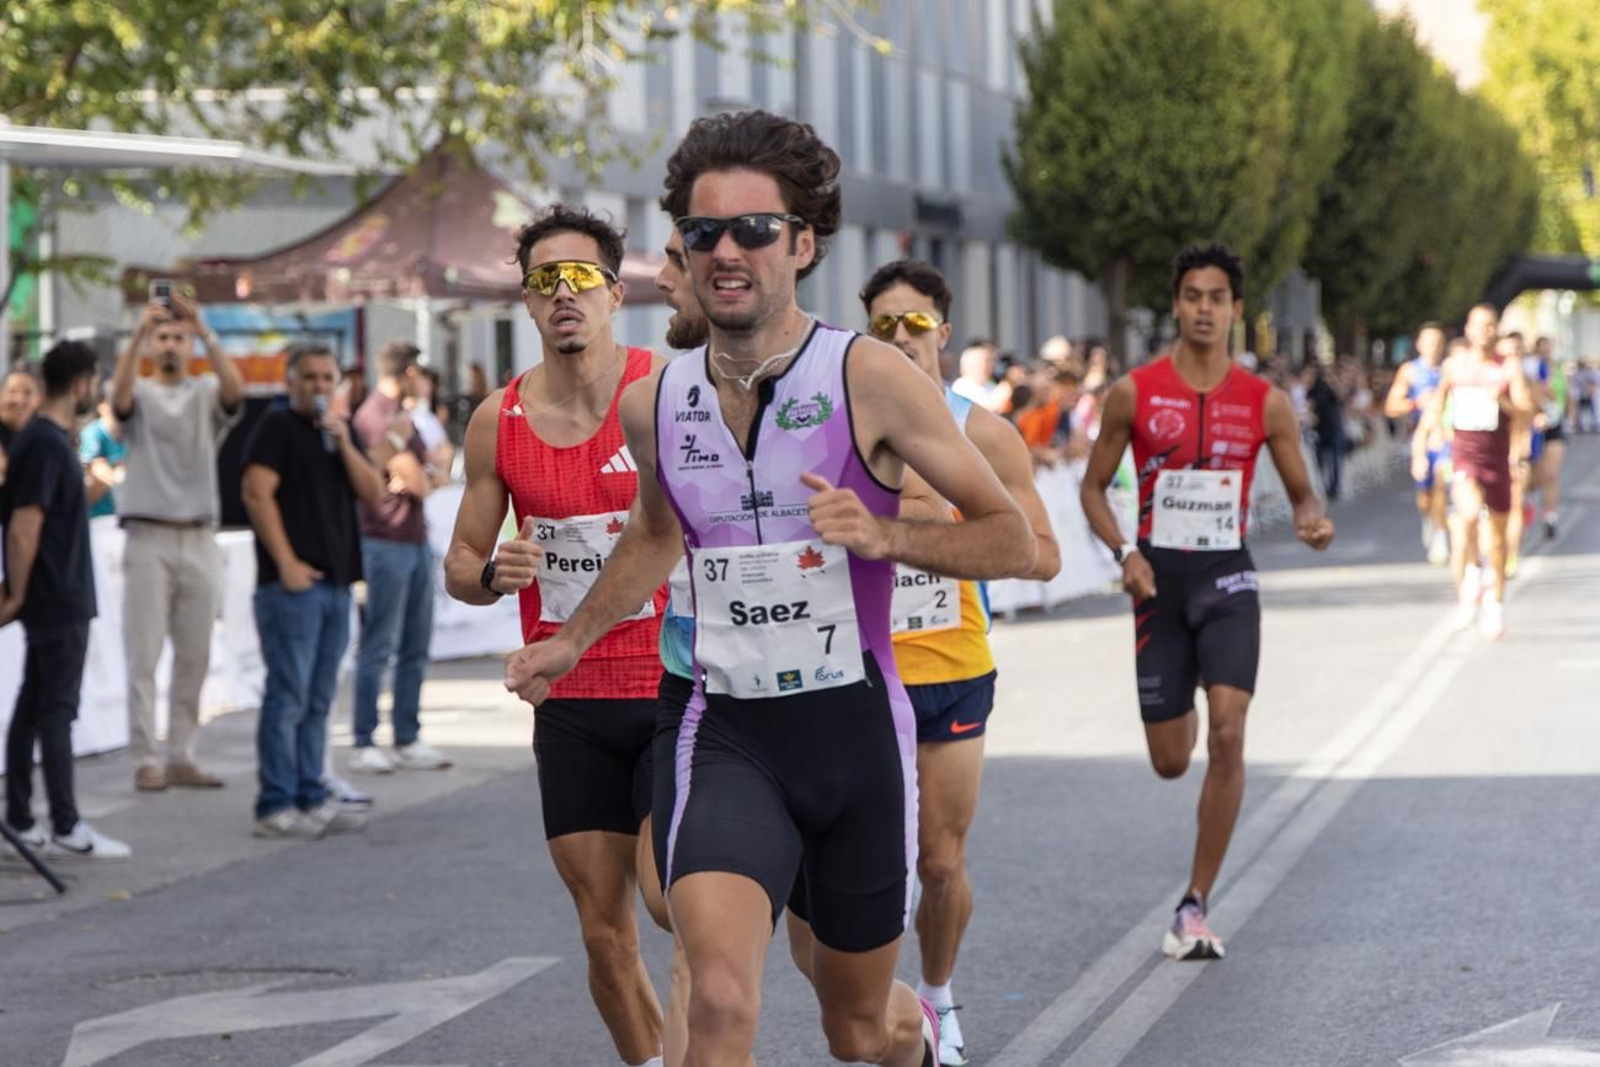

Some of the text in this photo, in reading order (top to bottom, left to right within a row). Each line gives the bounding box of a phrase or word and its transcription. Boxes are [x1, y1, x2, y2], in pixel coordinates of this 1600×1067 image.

[675, 411, 711, 422] VIATOR
[1162, 495, 1233, 512] Guzman
[759, 510, 769, 519] DE
[771, 507, 809, 518] ALBACET
[536, 523, 556, 540] 37
[1215, 515, 1234, 531] 14
[545, 551, 607, 572] Perei
[703, 557, 730, 582] 37
[895, 573, 941, 588] iach
[935, 589, 948, 609] 2
[729, 600, 811, 626] Saez
[816, 624, 837, 655] 7
